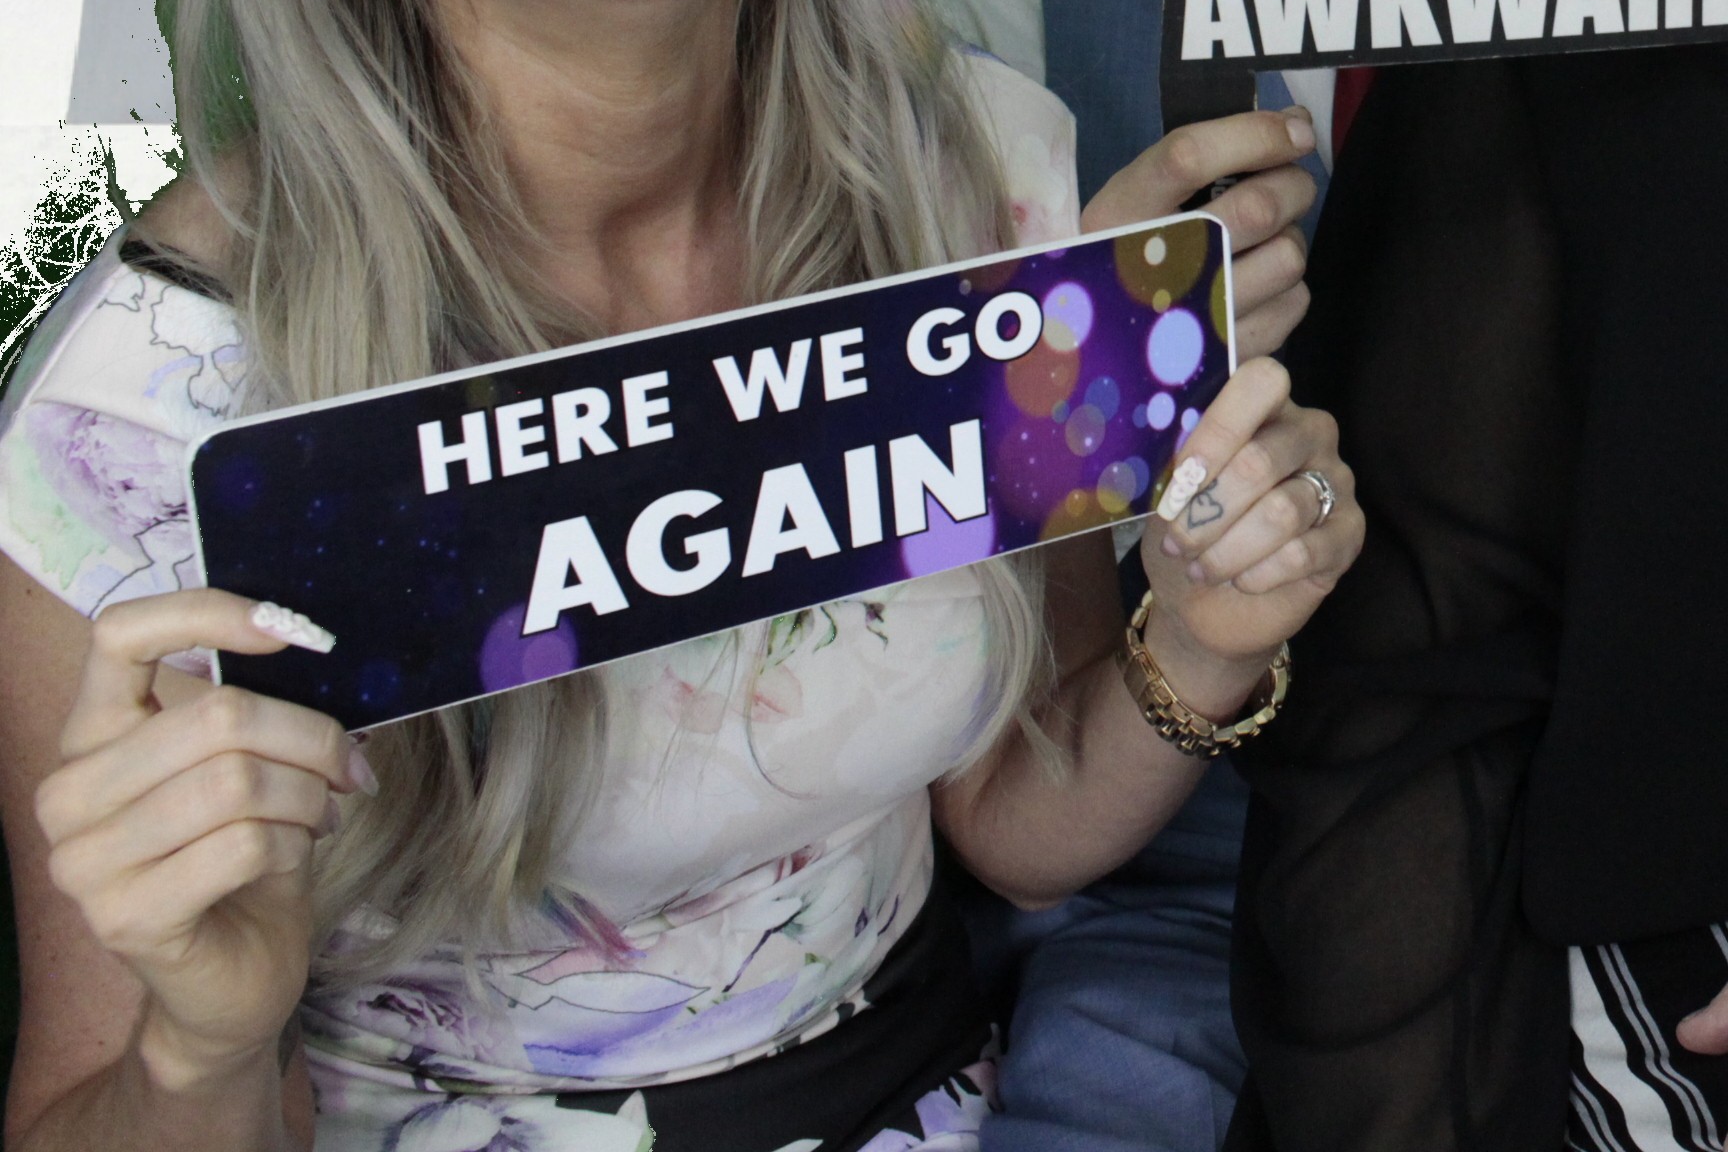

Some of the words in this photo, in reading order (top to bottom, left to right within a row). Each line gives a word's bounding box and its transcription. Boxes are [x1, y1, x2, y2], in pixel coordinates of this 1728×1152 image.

[418, 371, 674, 495] HERE
[712, 327, 867, 423] WE
[906, 291, 1045, 376] GO
[522, 419, 988, 636] AGAIN
